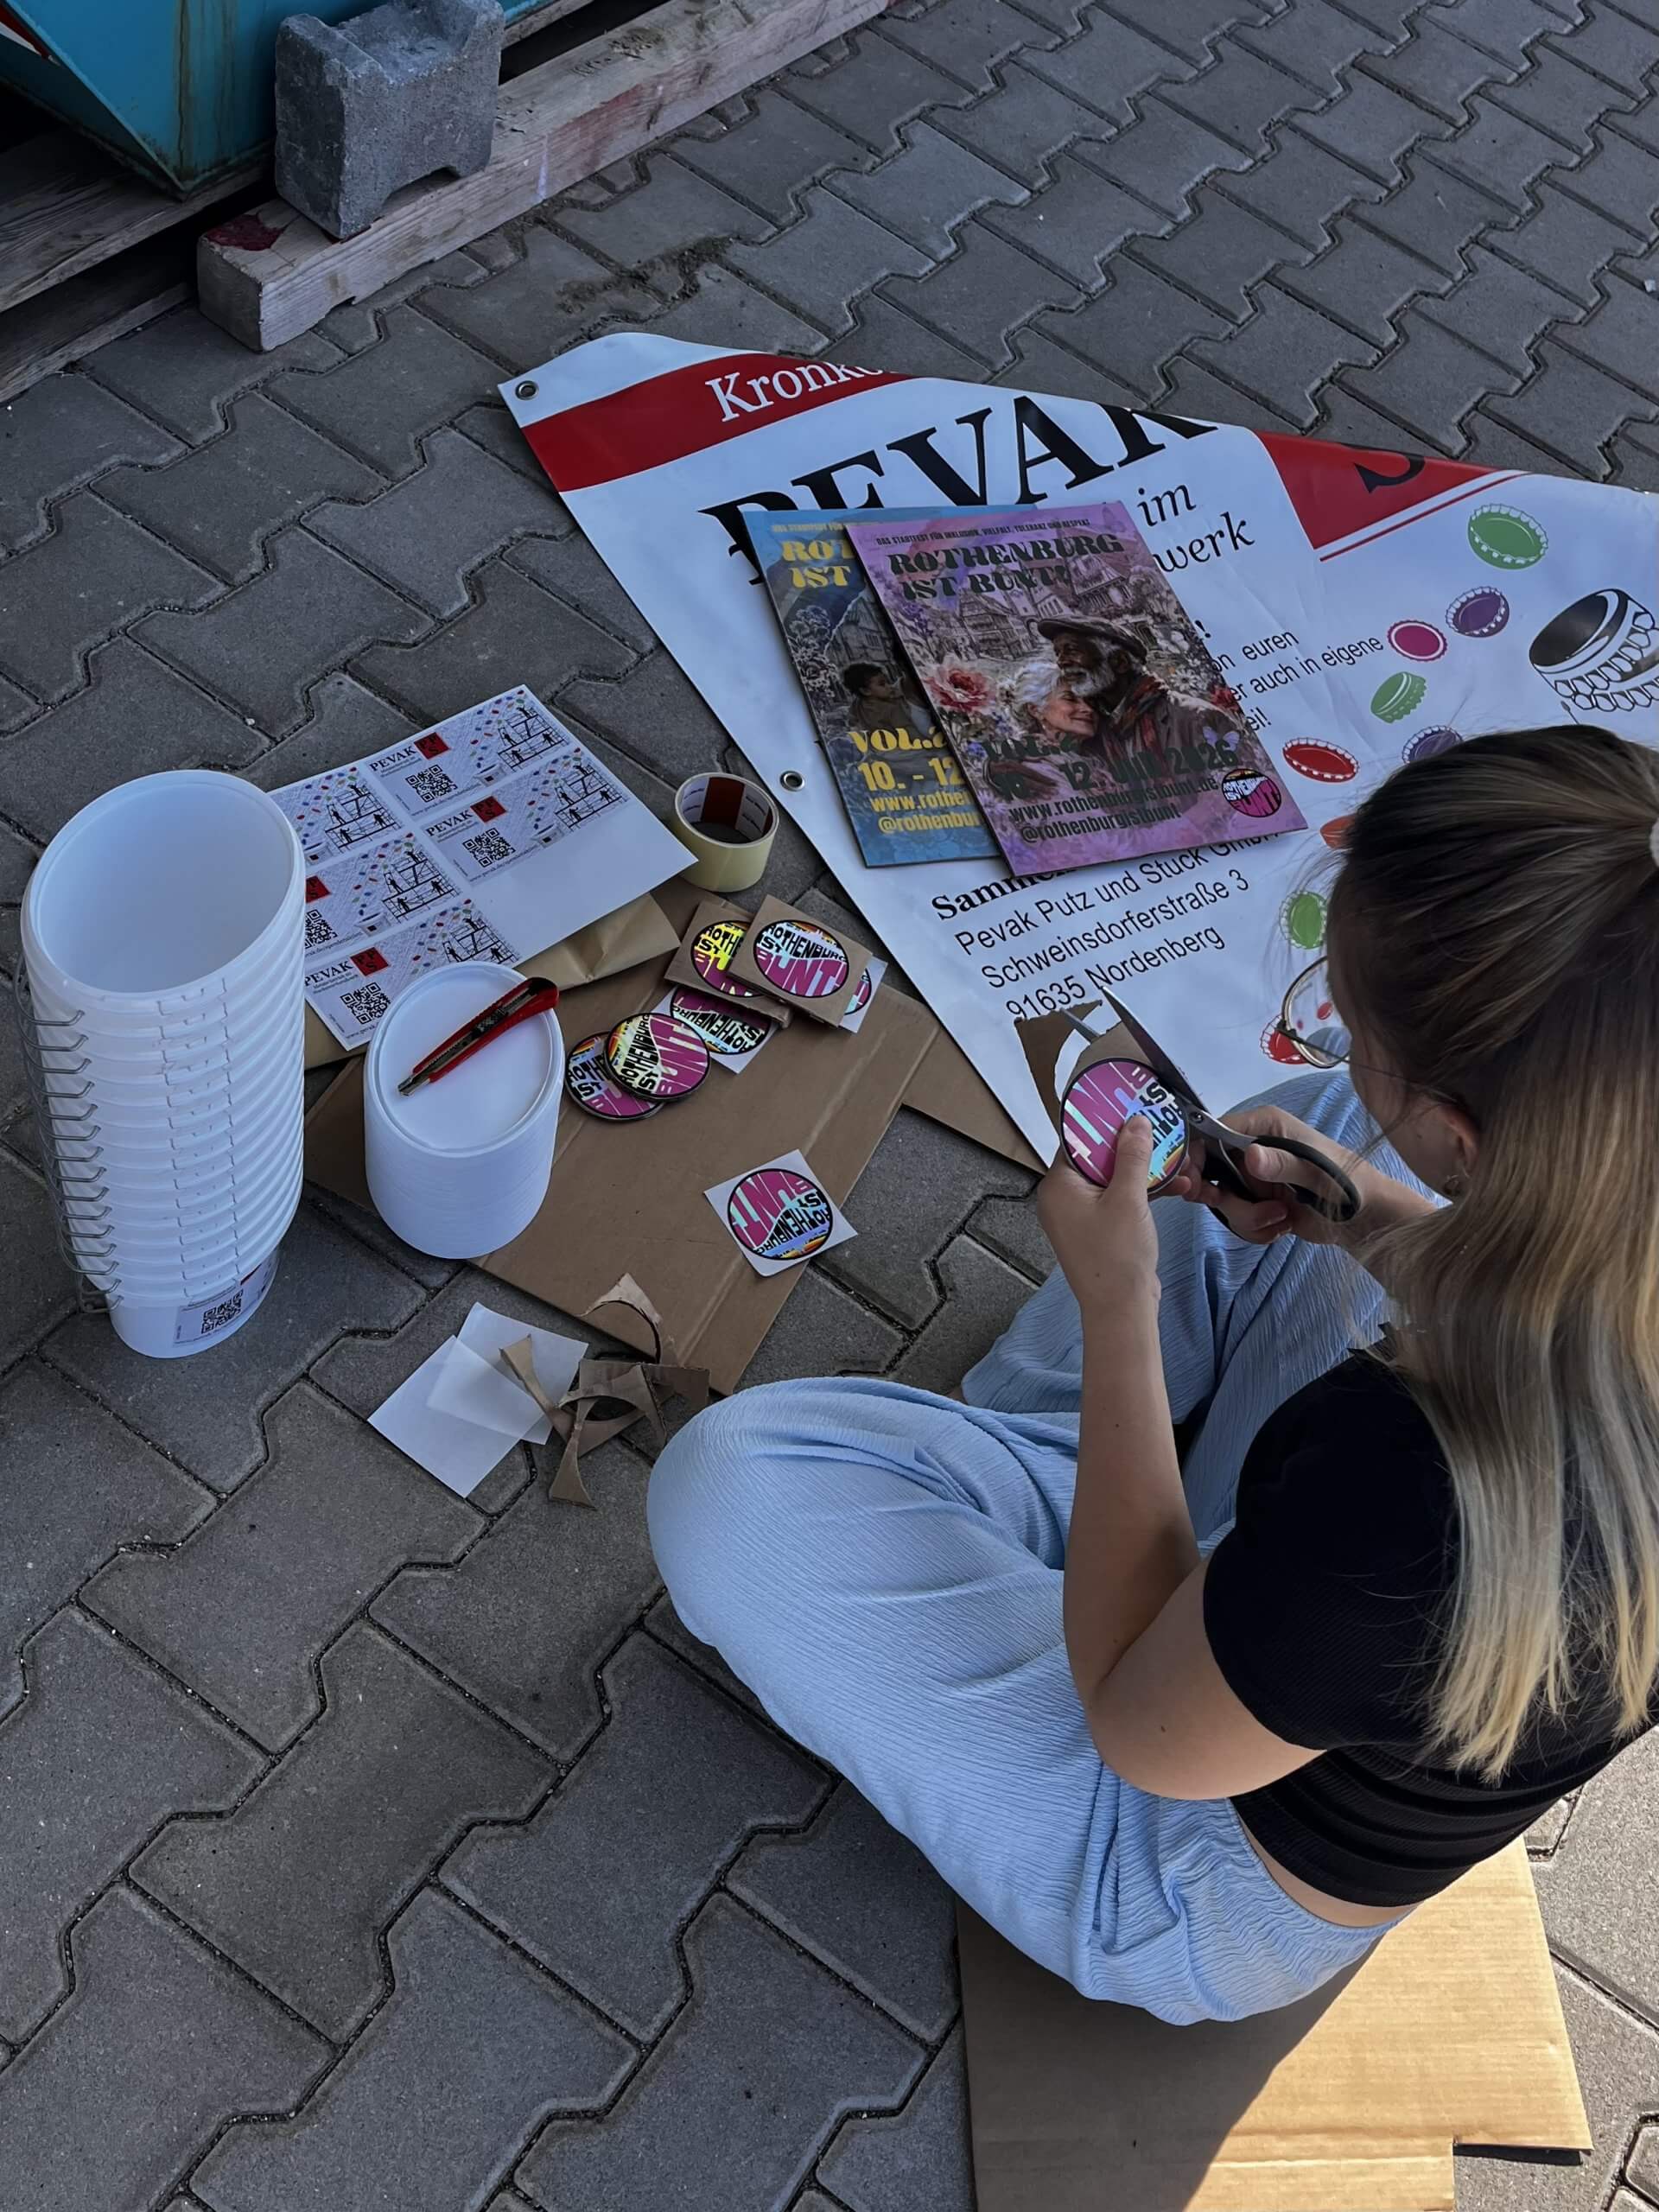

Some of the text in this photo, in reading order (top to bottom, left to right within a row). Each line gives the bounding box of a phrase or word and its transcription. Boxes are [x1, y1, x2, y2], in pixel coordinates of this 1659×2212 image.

[1136, 484, 1197, 527] im
[887, 533, 1124, 575] ROTHENBURG
[789, 566, 851, 588] IST
[899, 575, 961, 601] IST
[1242, 631, 1300, 660] euren
[1249, 663, 1301, 695] auch
[1295, 656, 1322, 675] in
[1320, 637, 1384, 666] eigene
[369, 746, 417, 772] PEVAK
[858, 760, 906, 791] 10.
[425, 809, 474, 837] PEVAK
[955, 907, 1039, 956] Pevak
[1034, 887, 1095, 924] Putz
[1094, 870, 1142, 904] und
[1139, 847, 1210, 885] Stuck
[762, 924, 847, 962] ROTHENBURG
[981, 868, 1249, 989] Schweinsdorferstraße 3
[304, 960, 354, 987] PEVAK
[1005, 925, 1225, 1019] 91635 Nordenberg
[620, 1014, 660, 1085] ROTHENBURG
[755, 1209, 830, 1254] ROTHENBURG
